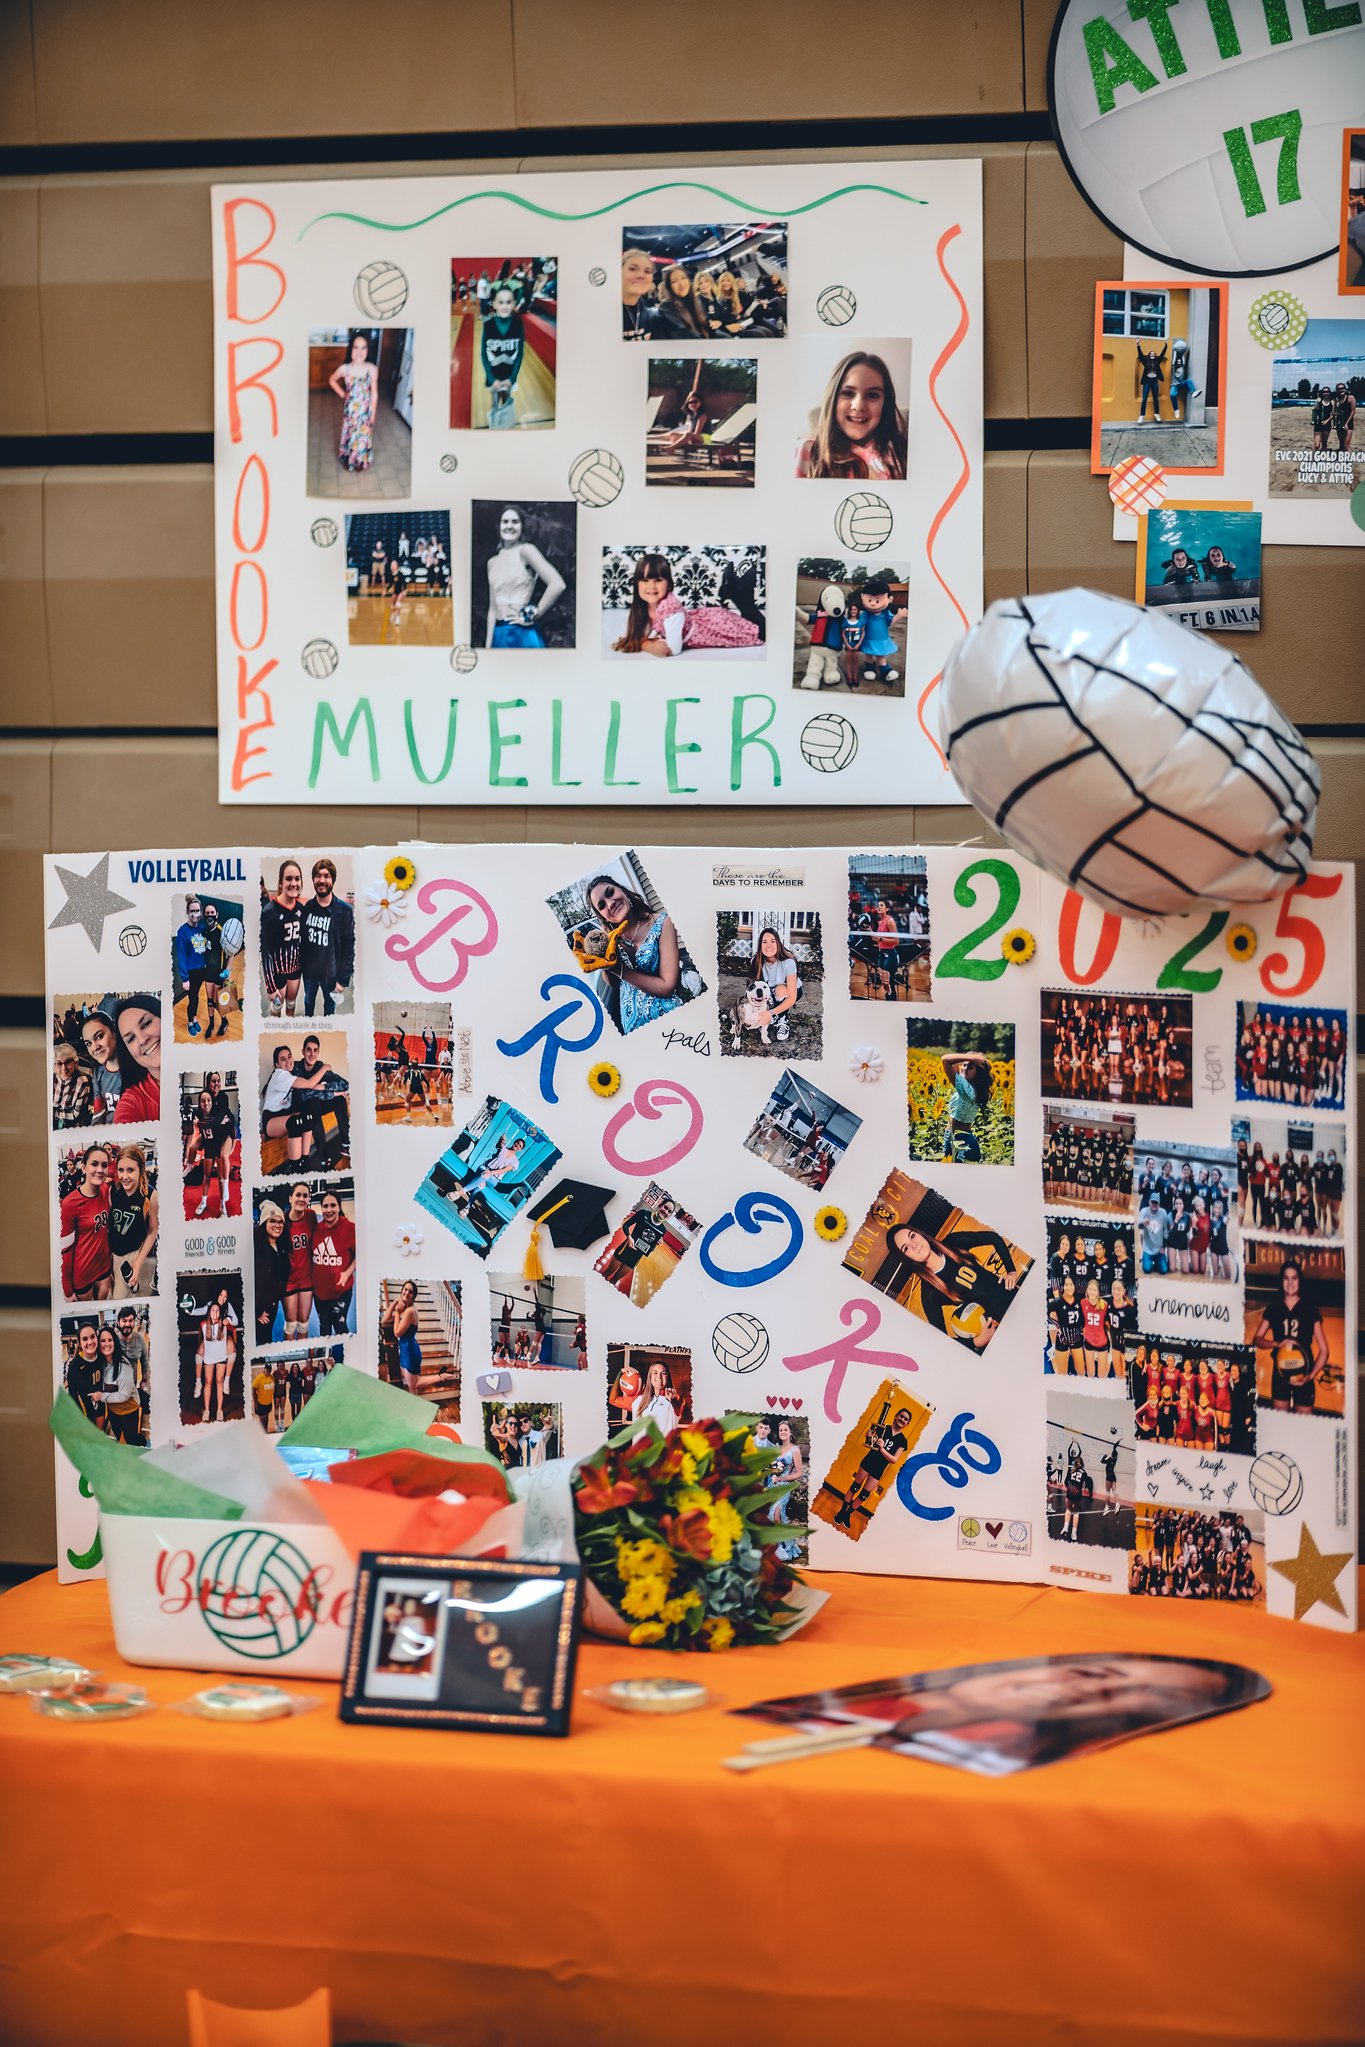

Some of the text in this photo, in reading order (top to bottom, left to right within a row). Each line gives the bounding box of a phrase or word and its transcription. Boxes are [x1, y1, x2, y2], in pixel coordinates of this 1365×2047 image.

[1222, 108, 1303, 219] 17
[486, 338, 520, 352] SPIRIT
[1275, 450, 1292, 461] EVC
[1292, 450, 1313, 461] 2021
[1314, 451, 1337, 462] GOLD
[1297, 472, 1319, 483] LUCY
[1320, 473, 1327, 483] &
[223, 197, 287, 791] BROOKE
[1205, 610, 1216, 626] 6
[307, 694, 782, 794] MUELLER
[128, 858, 247, 884] VOLLEYBALL
[712, 866, 744, 879] These
[767, 868, 786, 879] the
[753, 879, 804, 887] REMEMBER
[284, 920, 301, 942] 32
[308, 927, 329, 947] 3:16
[263, 1021, 292, 1031] through
[94, 1209, 109, 1233] 28
[112, 1207, 136, 1236] 27
[184, 1235, 237, 1256] GOOD & GOOD
[291, 1232, 308, 1251] 28
[848, 1226, 880, 1262] COAL
[1309, 1252, 1338, 1267] CITY
[955, 1265, 978, 1290] 10
[1087, 1311, 1100, 1326] 52
[1148, 1297, 1230, 1323] memories
[1108, 1312, 1120, 1329] 19
[1282, 1317, 1300, 1338] 12
[884, 1438, 894, 1451] 12
[1145, 1458, 1172, 1477] dream
[1195, 1455, 1227, 1477] laugh
[1171, 1467, 1194, 1492] inspire
[986, 1541, 998, 1549] Love
[1003, 1542, 1028, 1553] Volleyball
[1049, 1564, 1113, 1583] SPIKE
[155, 1549, 355, 1630] Brooke
